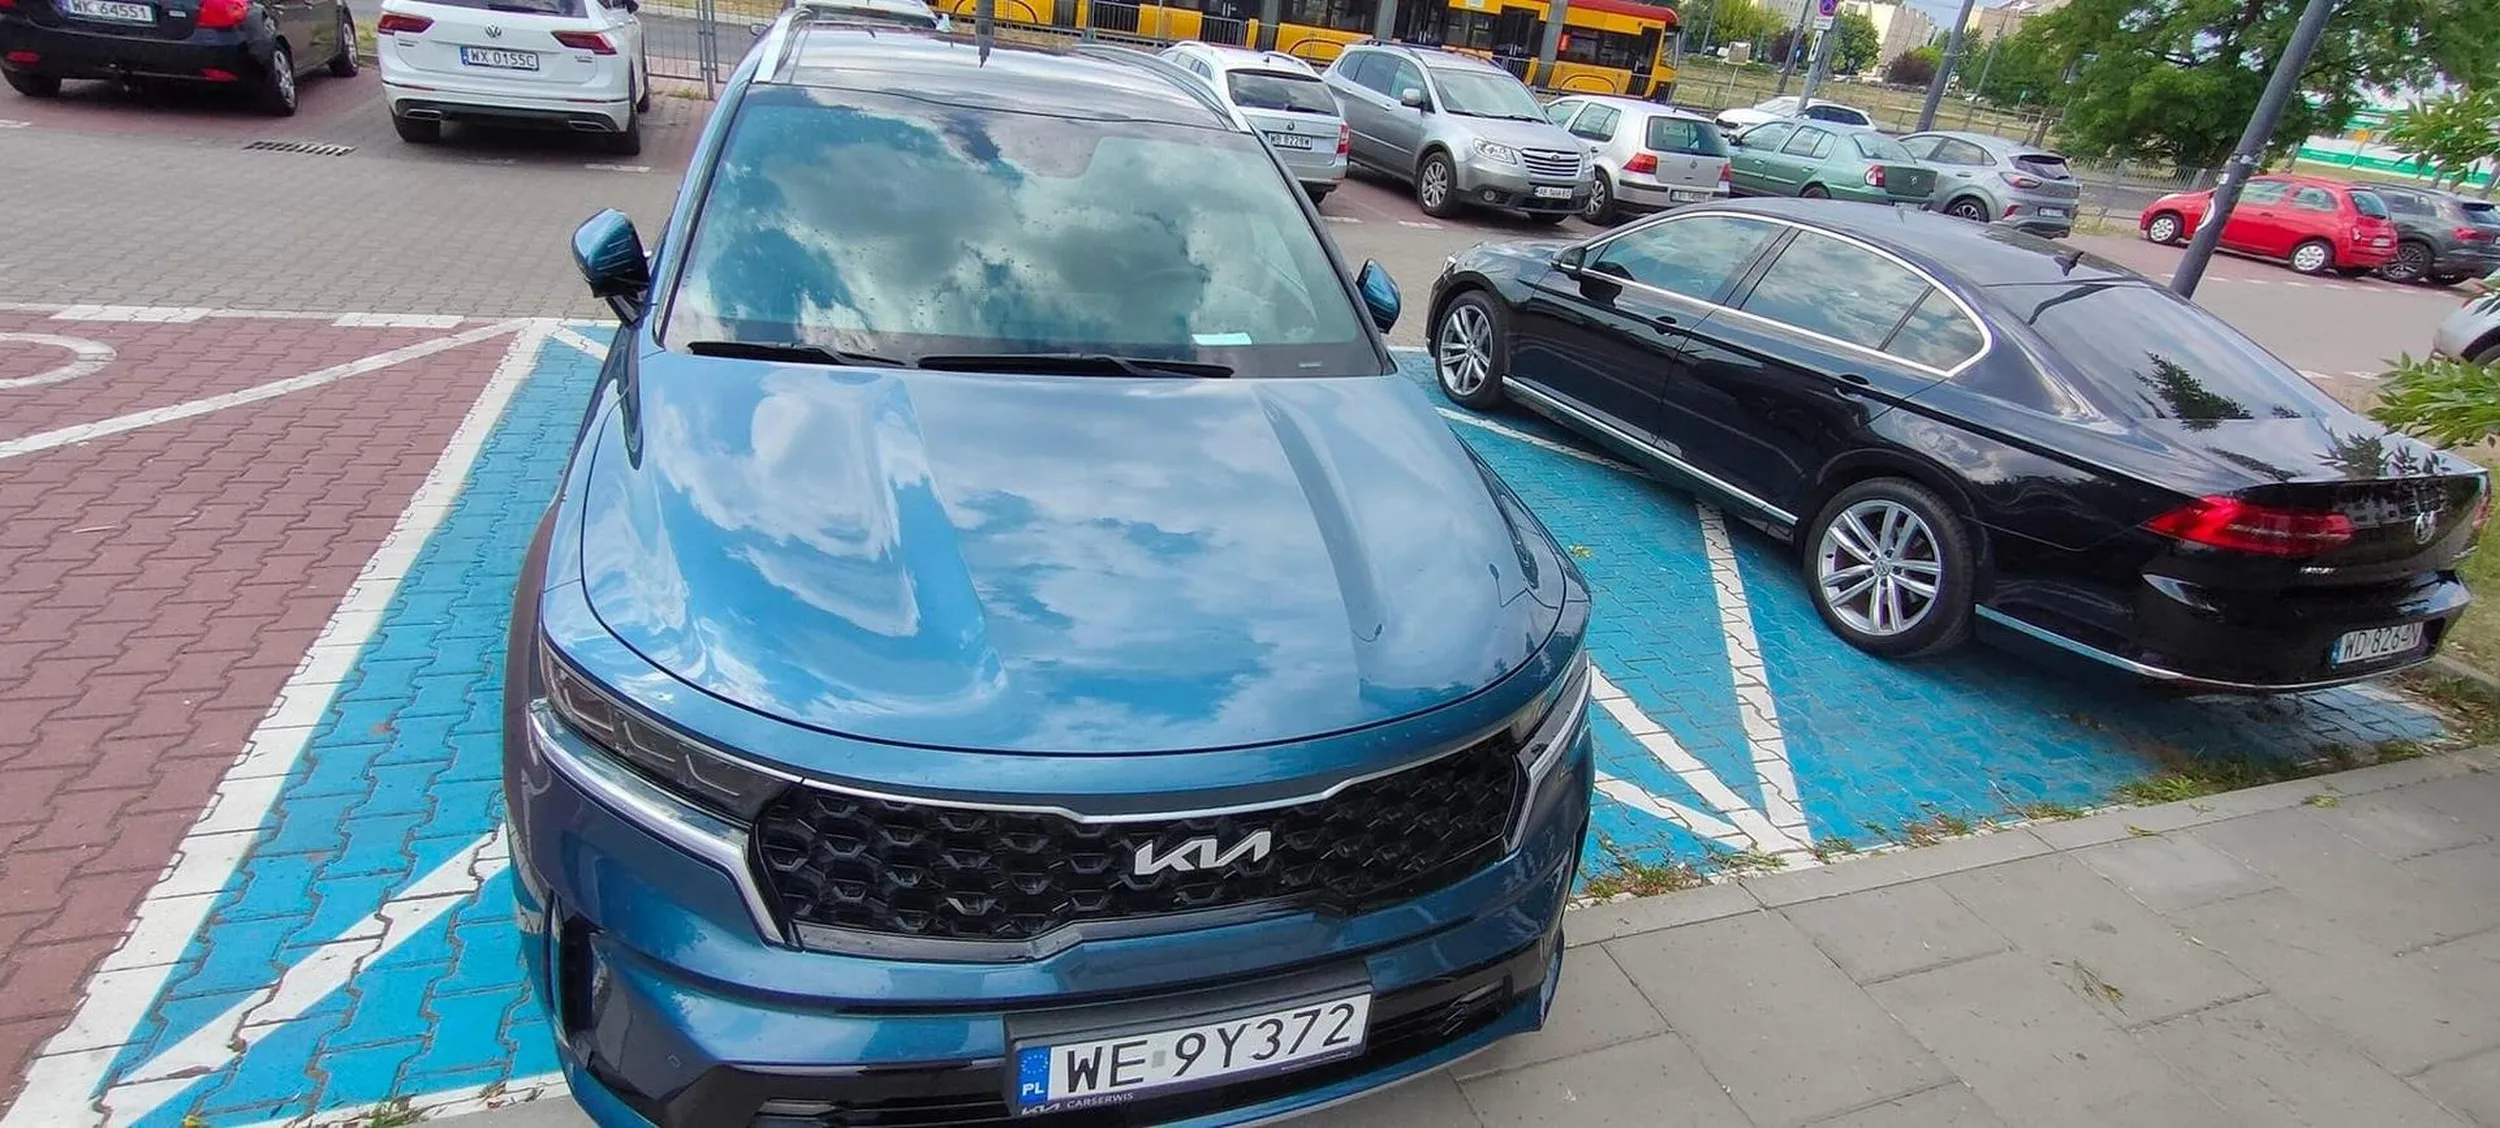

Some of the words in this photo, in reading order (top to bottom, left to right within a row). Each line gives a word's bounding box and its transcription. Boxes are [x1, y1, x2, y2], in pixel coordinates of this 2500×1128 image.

[470, 49, 489, 63] WX
[493, 52, 535, 67] 0155C
[2343, 631, 2367, 659] WD
[1133, 828, 1272, 876] KIA
[1066, 1039, 1148, 1094] WE
[1172, 1003, 1355, 1078] 9Y372
[1021, 1082, 1045, 1096] PL
[1066, 1092, 1135, 1109] CARSERWIS
